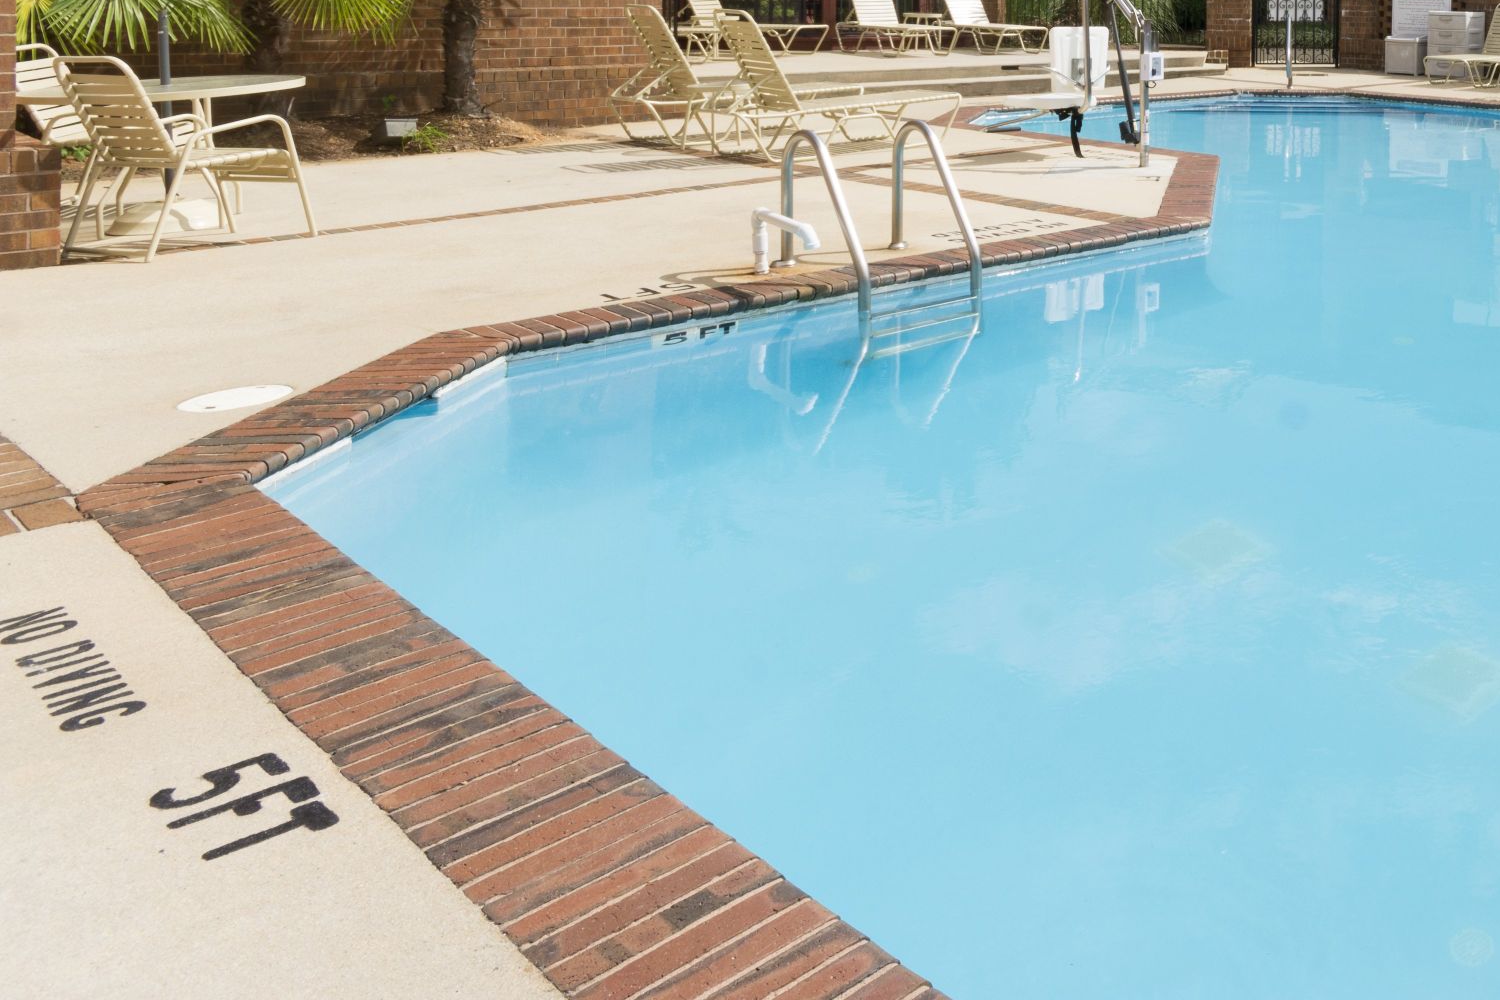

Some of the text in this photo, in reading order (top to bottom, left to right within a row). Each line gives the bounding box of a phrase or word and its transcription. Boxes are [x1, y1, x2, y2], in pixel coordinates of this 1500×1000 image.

[0, 606, 147, 732] NO DIVING
[149, 752, 340, 861] 5FT
